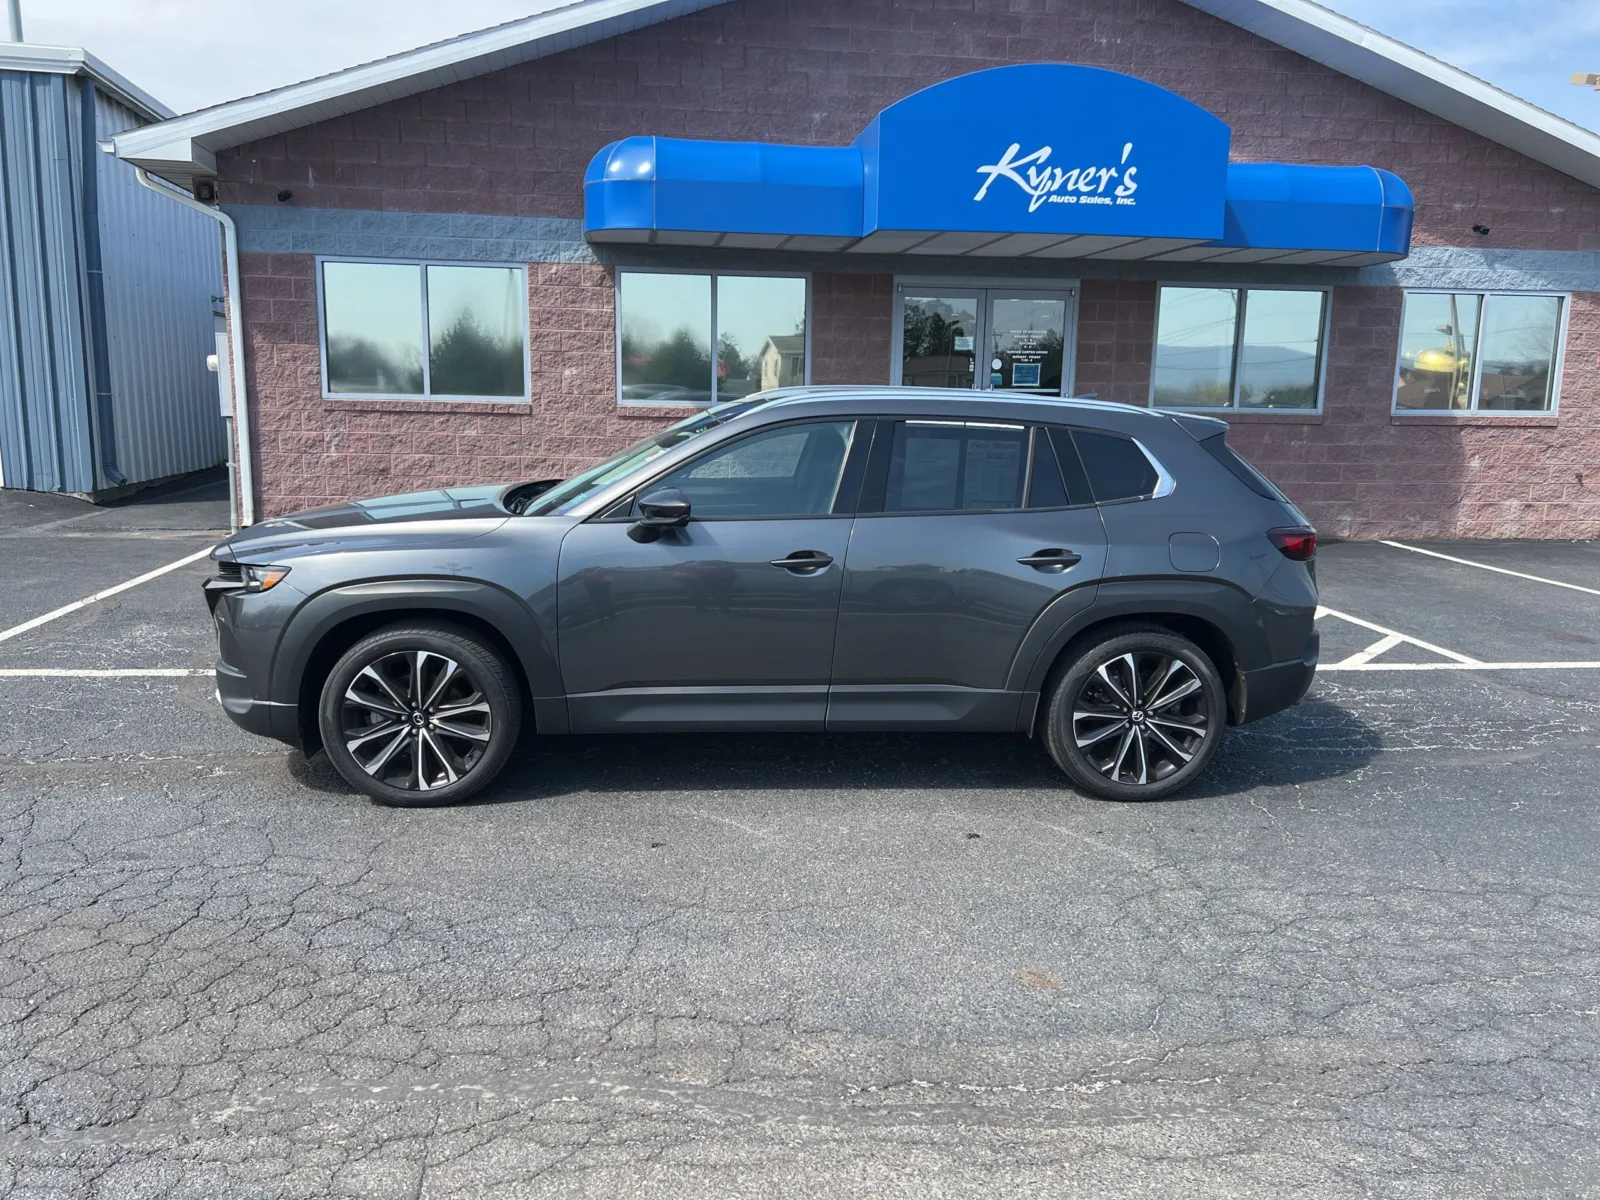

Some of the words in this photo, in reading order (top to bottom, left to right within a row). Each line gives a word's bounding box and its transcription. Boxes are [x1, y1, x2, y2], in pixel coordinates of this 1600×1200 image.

[973, 142, 1138, 213] Kyner's
[1048, 194, 1077, 204] Auto
[1079, 195, 1113, 206] Sales,
[1116, 196, 1137, 205] Inc.
